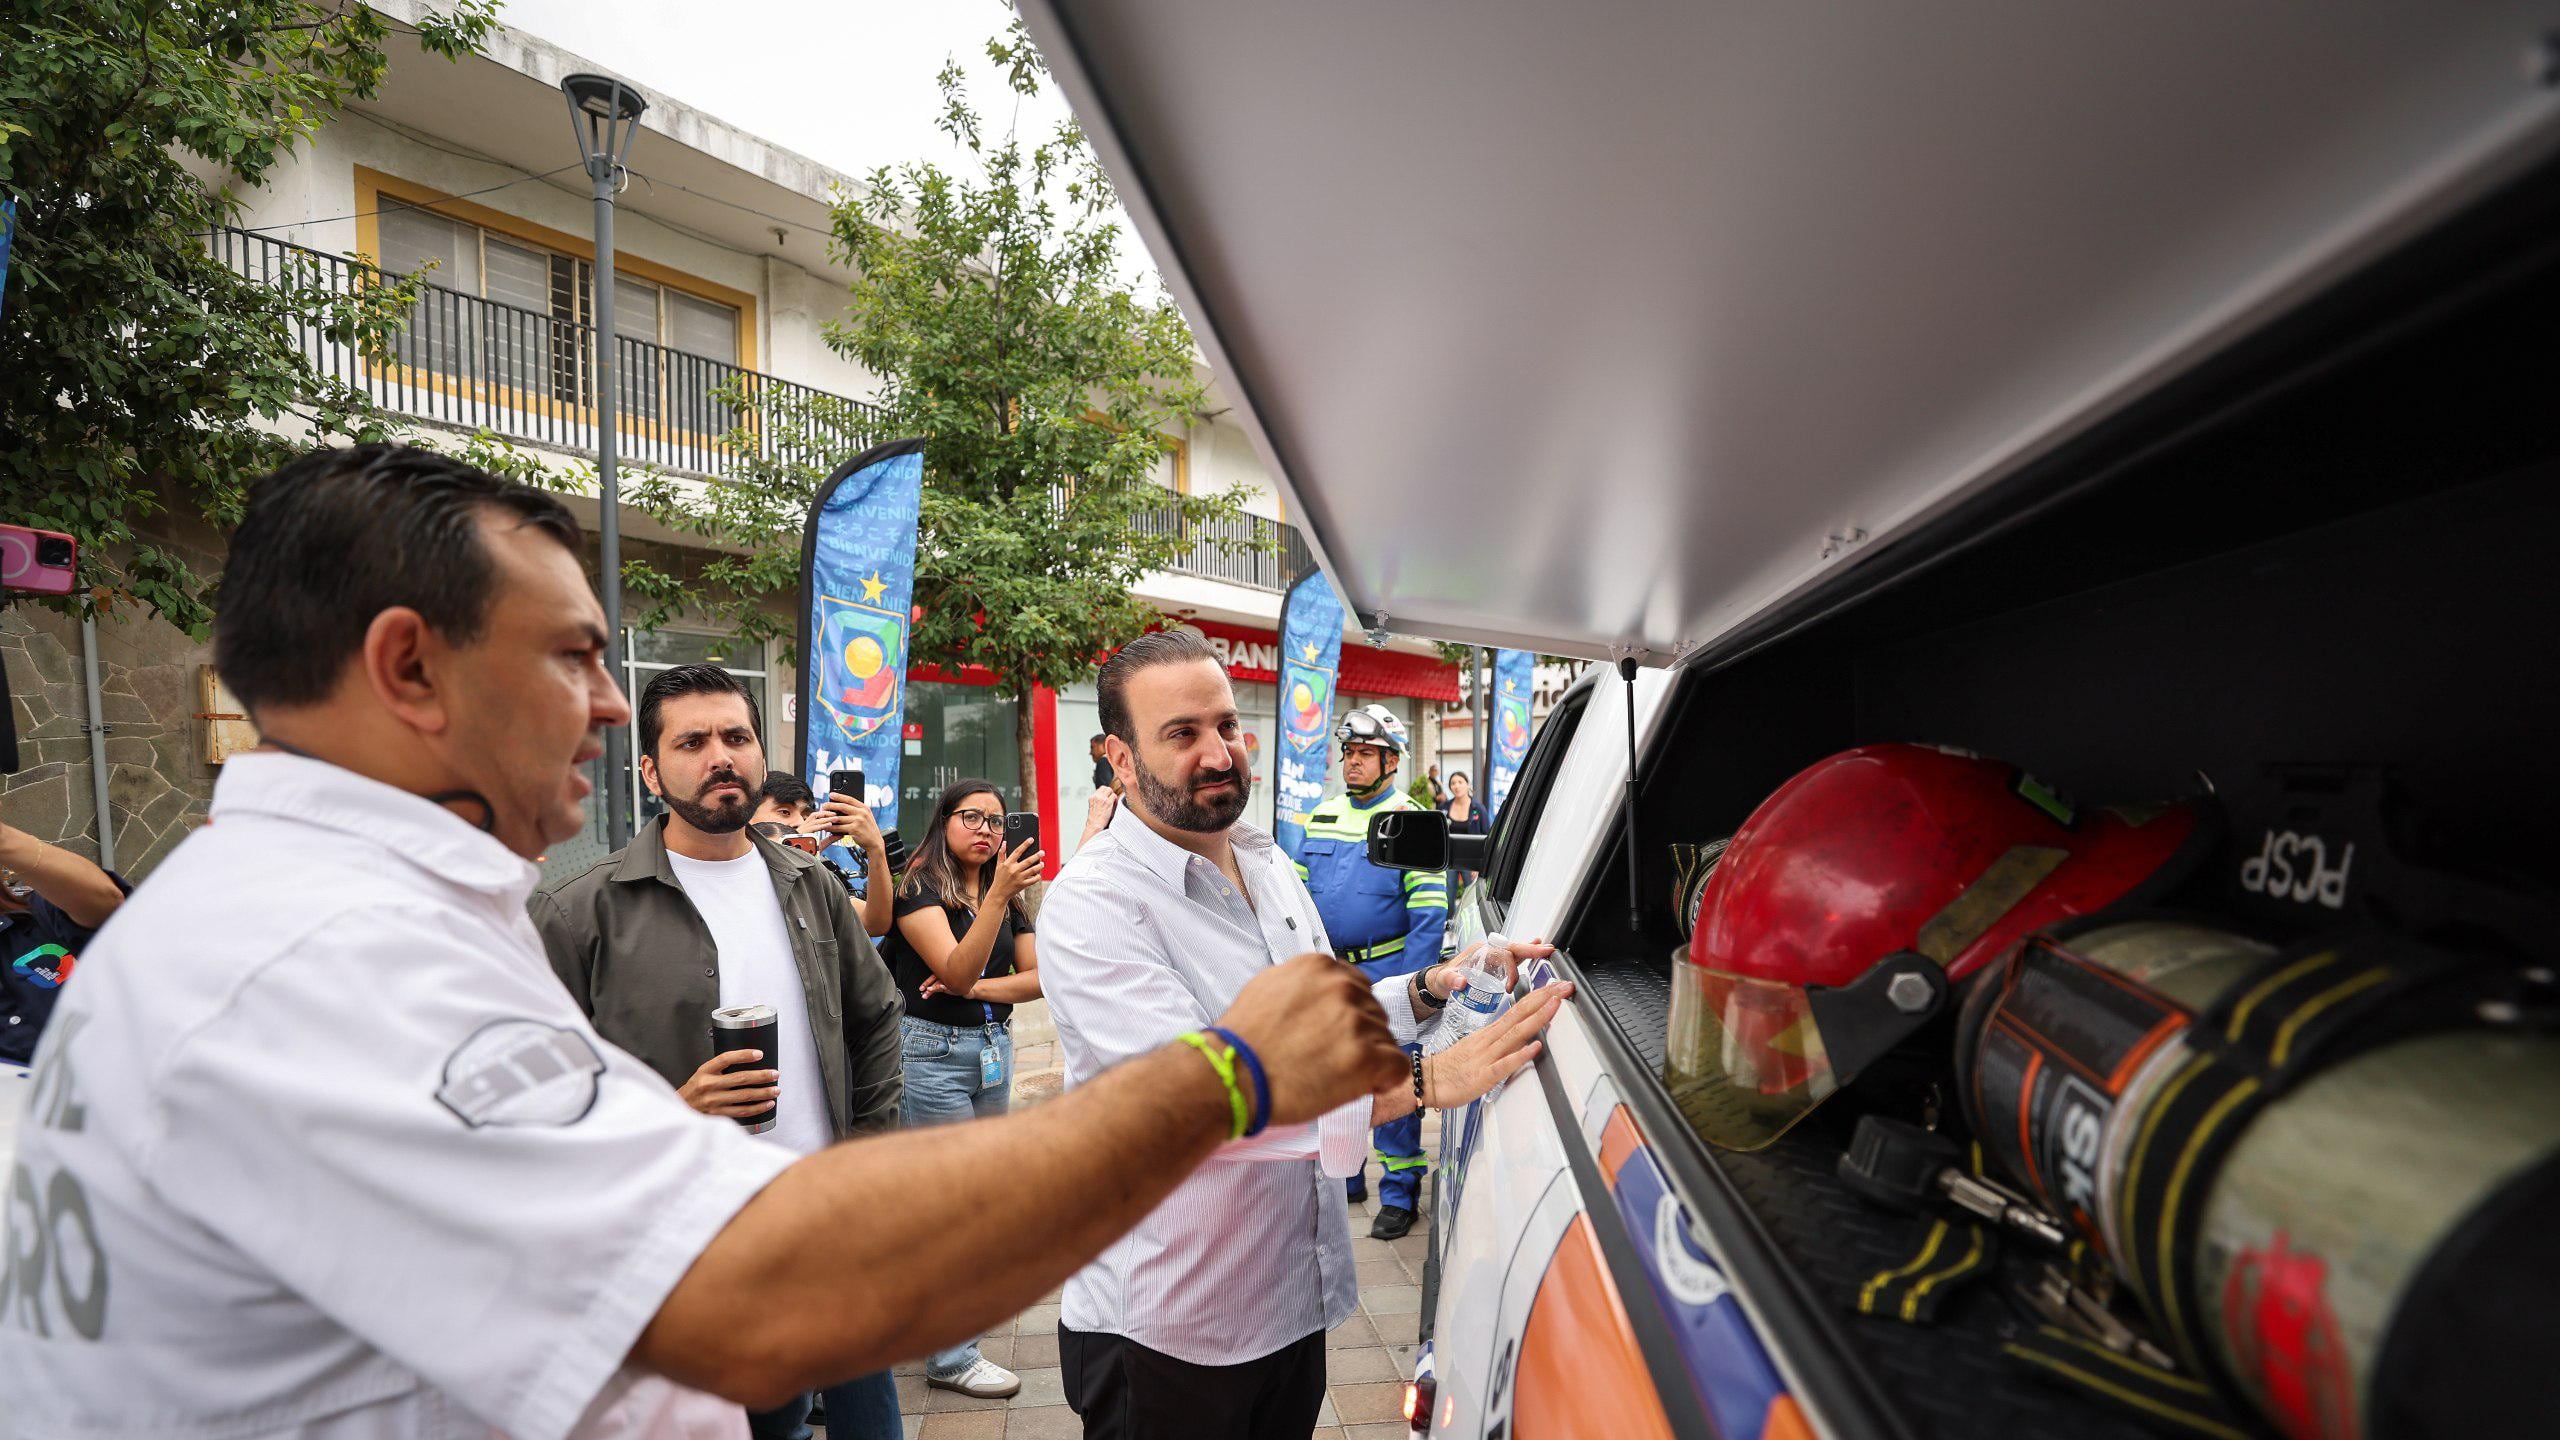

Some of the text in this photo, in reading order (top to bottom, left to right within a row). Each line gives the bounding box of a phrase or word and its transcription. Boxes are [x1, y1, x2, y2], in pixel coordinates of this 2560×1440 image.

[833, 520, 901, 543] ようこそ
[832, 560, 896, 589] ようそ
[1209, 636, 1279, 673] BAN
[812, 774, 894, 808] PRO
[2240, 829, 2355, 909] PCSP
